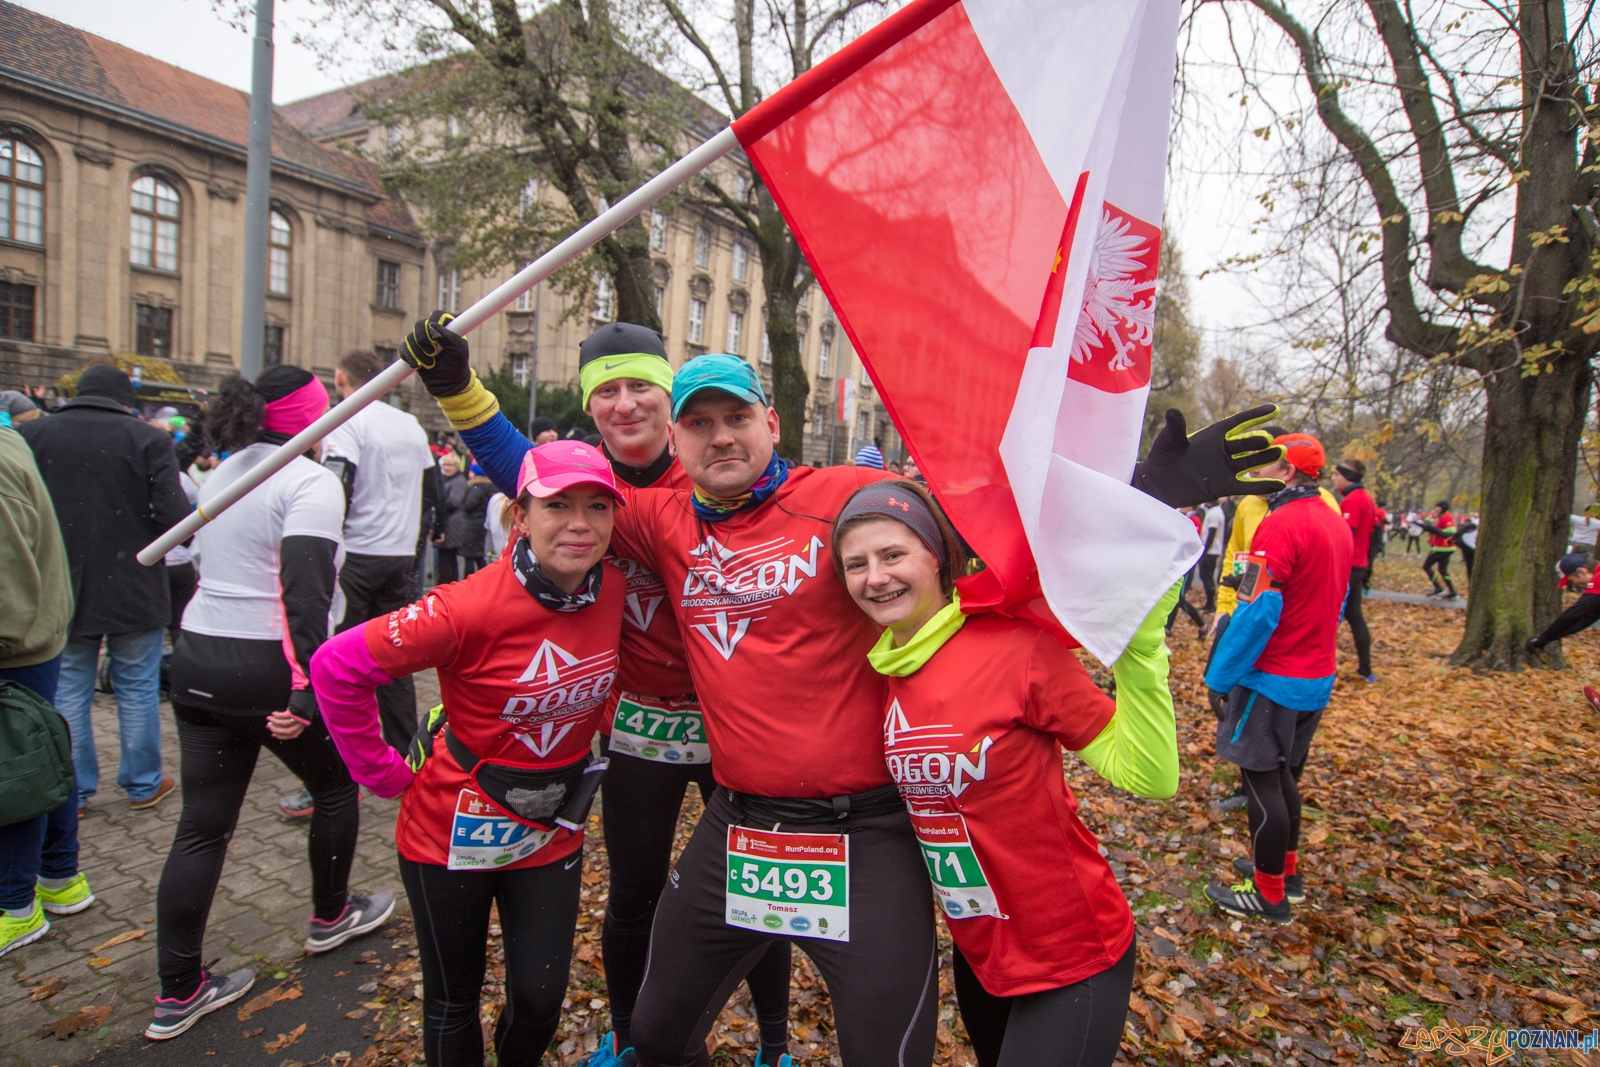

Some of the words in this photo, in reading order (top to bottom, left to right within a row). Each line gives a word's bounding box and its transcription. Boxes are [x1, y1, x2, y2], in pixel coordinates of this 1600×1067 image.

[625, 710, 701, 741] 4772
[647, 740, 671, 748] Marcin
[918, 826, 960, 837] RunPoland.org
[785, 845, 838, 856] RunPoland.org
[740, 862, 834, 902] 5493
[731, 908, 748, 918] GRUPA
[767, 903, 798, 913] Tomasz
[731, 914, 751, 925] LUXMED
